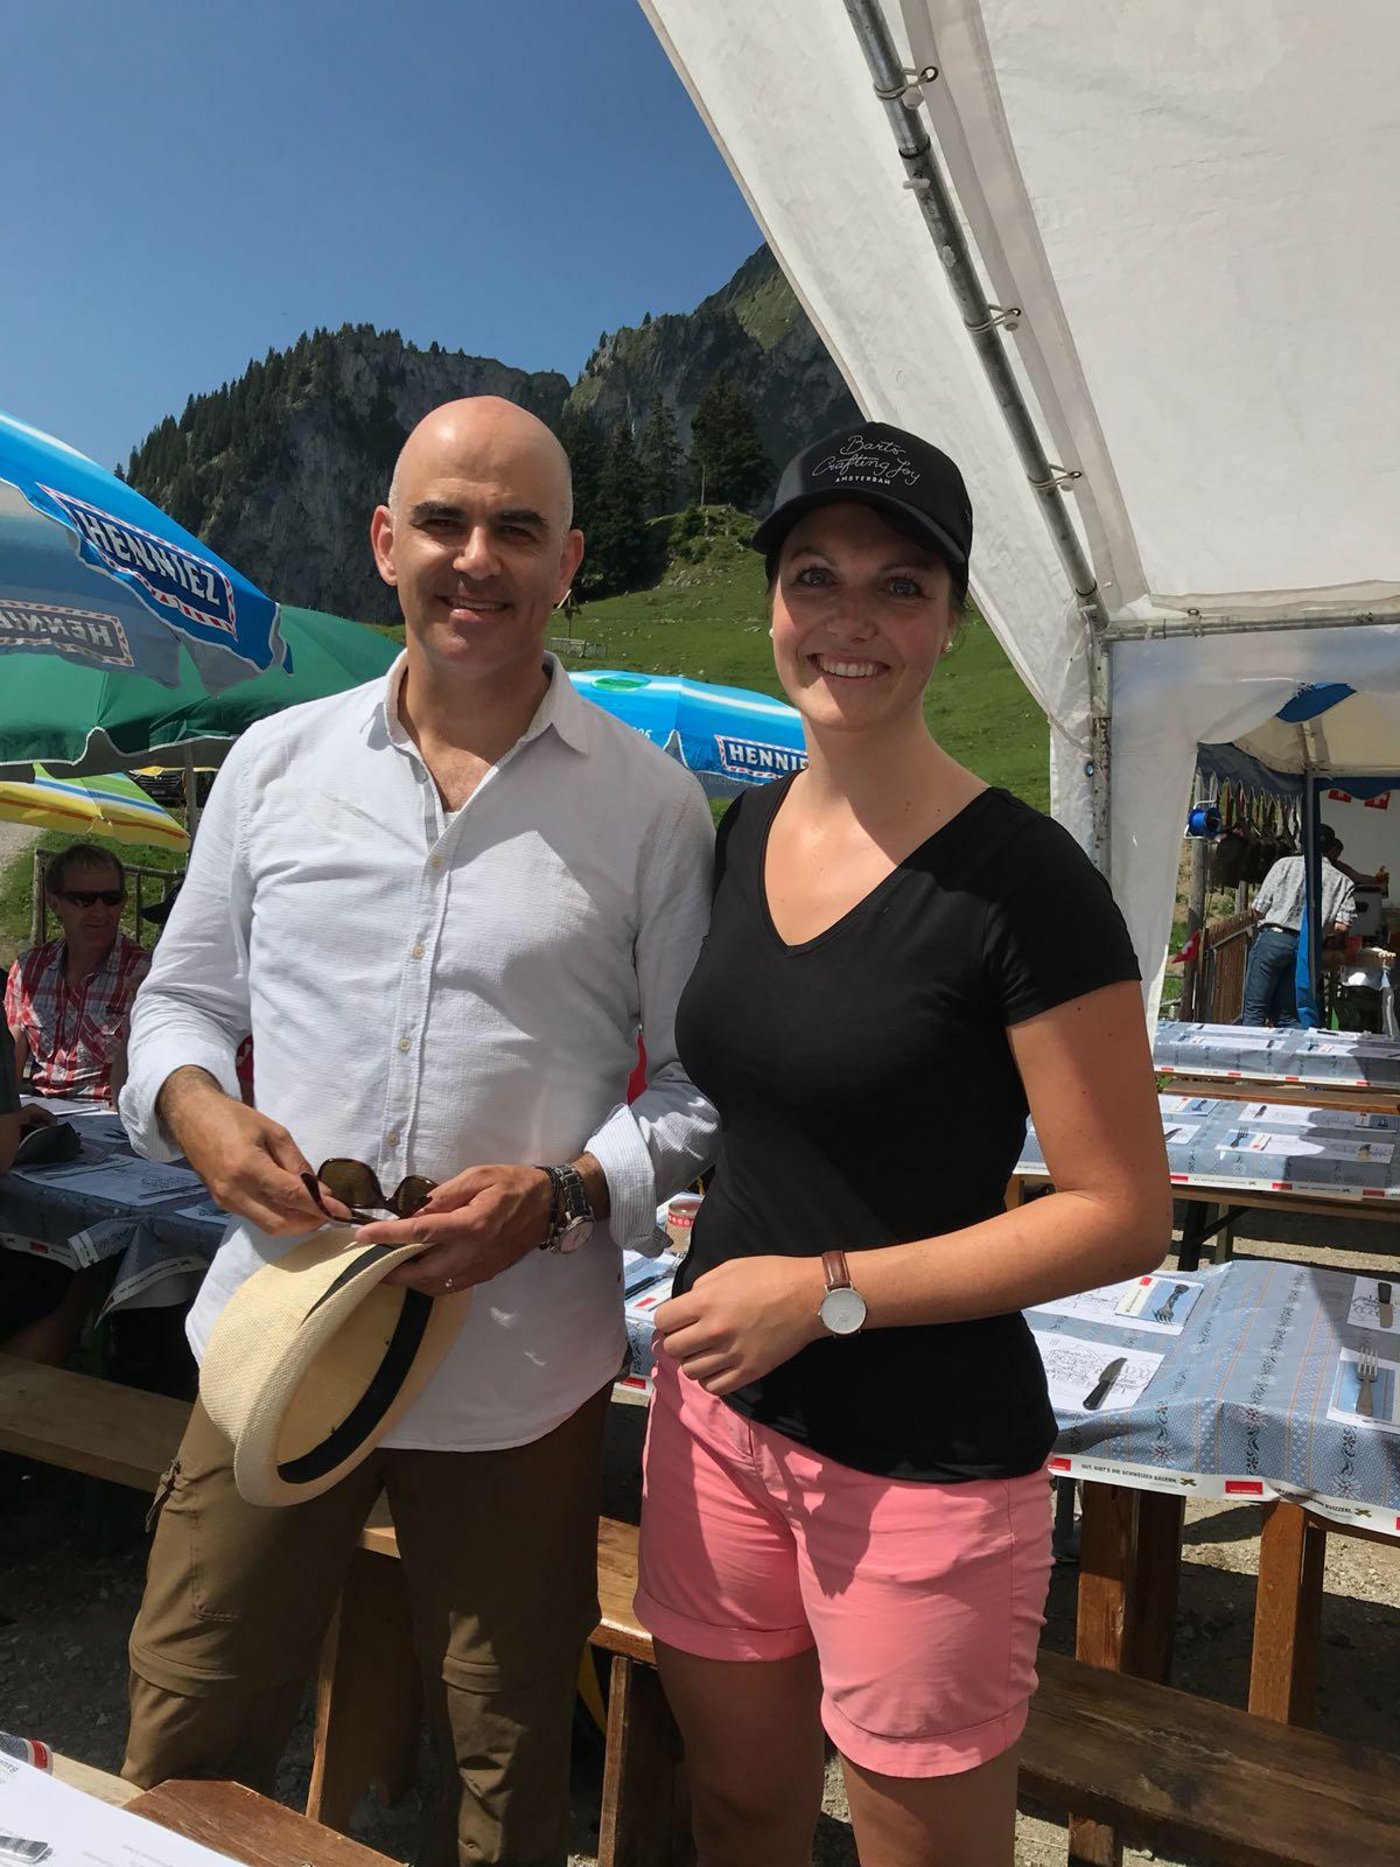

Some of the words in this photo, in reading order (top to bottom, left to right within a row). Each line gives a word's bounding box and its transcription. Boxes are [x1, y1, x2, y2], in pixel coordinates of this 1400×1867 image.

[812, 454, 890, 476] Crafting
[885, 458, 920, 486] Joy
[834, 475, 891, 485] AMSTERDAM
[74, 509, 220, 606] HENNIEZ
